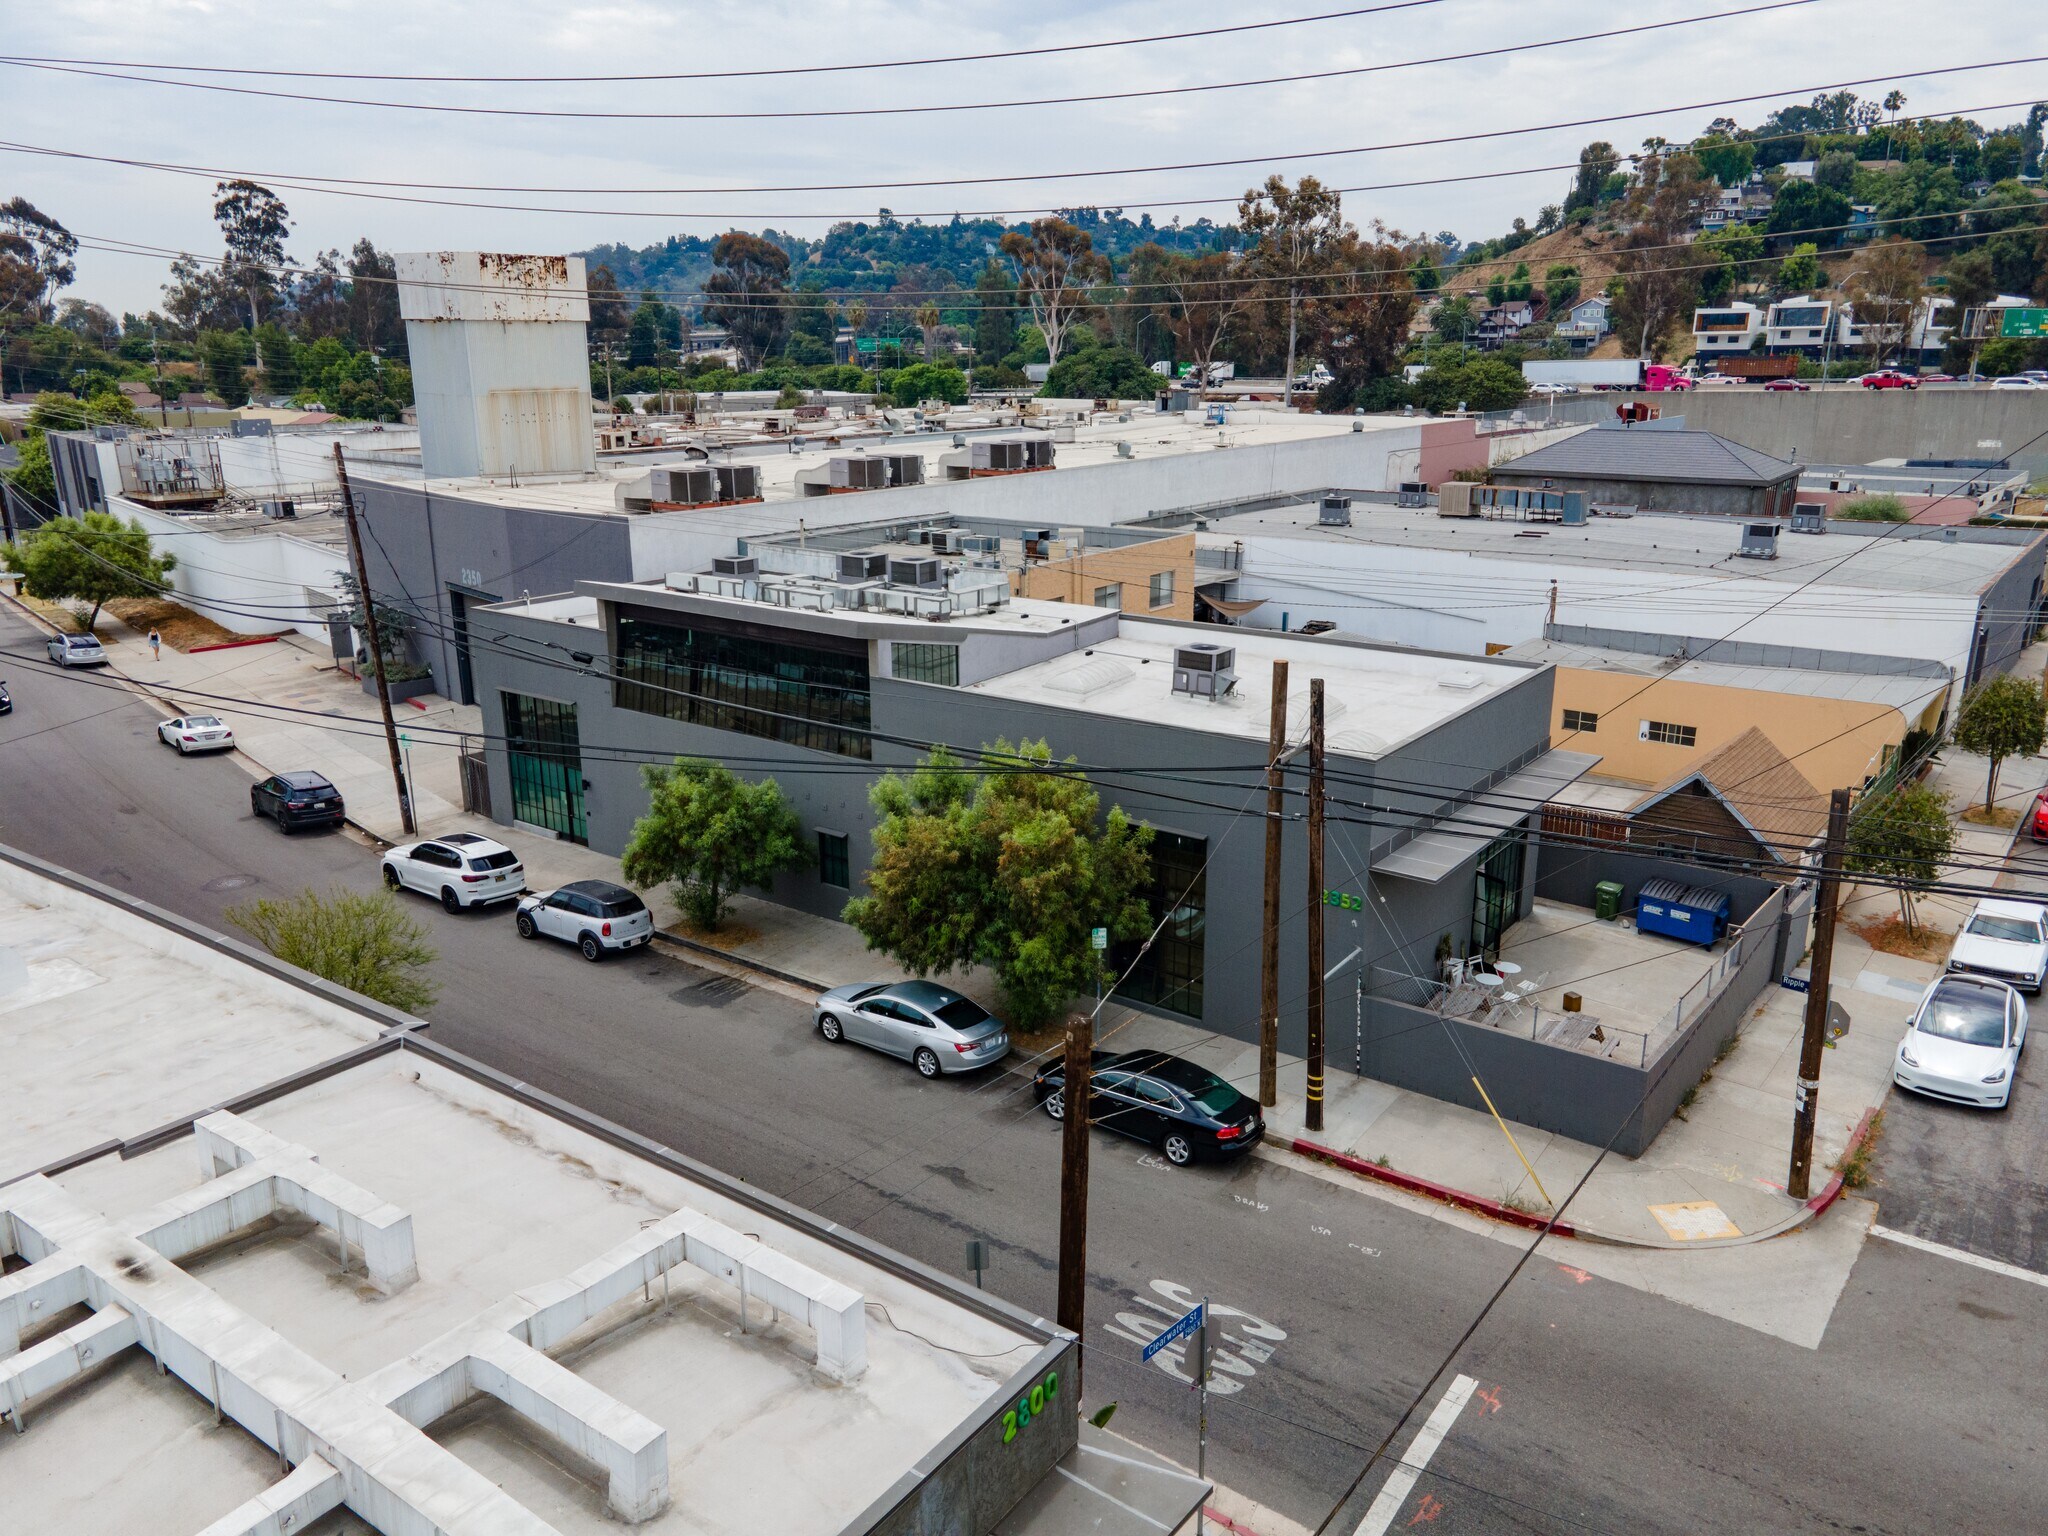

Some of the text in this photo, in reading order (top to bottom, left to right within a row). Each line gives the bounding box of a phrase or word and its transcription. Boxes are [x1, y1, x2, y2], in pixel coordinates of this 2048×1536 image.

[461, 567, 481, 588] 2350
[1323, 888, 1361, 911] 2352
[1783, 976, 1805, 988] Ripple
[1311, 1225, 1332, 1236] USA
[1103, 1279, 1287, 1394] STOP
[1148, 1311, 1197, 1355] Clearwater St
[1002, 1371, 1058, 1444] 2800
